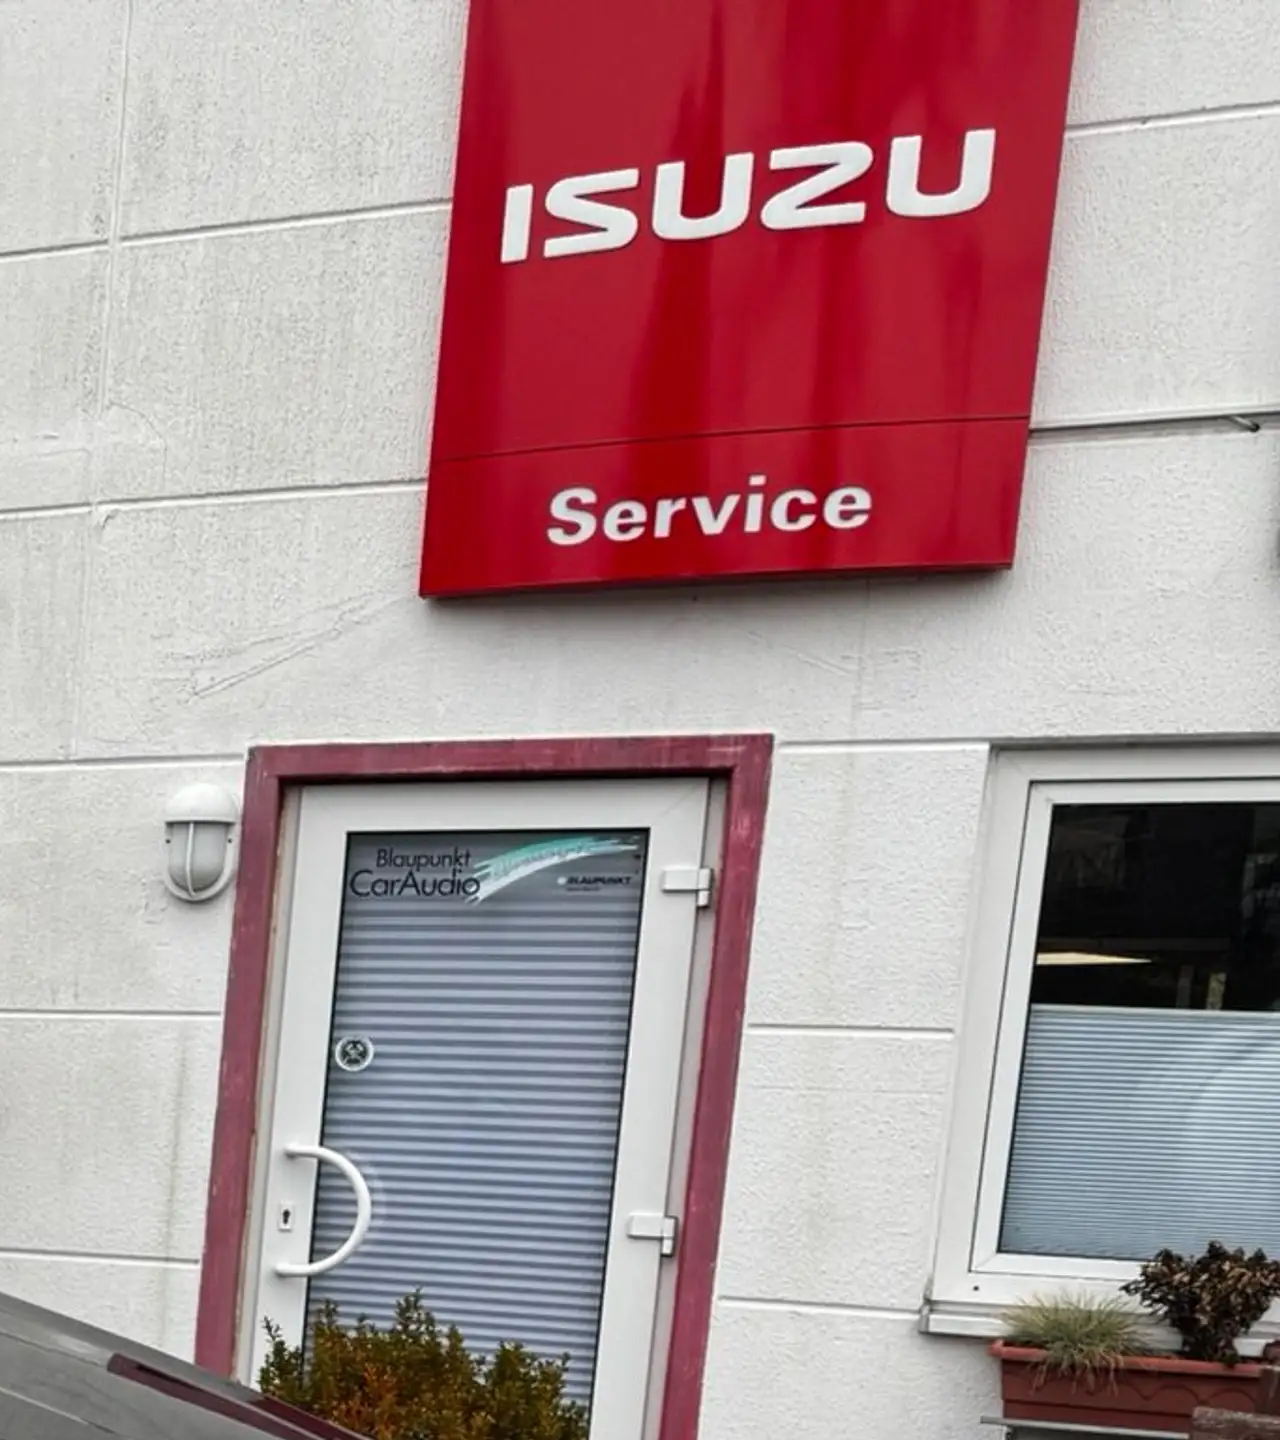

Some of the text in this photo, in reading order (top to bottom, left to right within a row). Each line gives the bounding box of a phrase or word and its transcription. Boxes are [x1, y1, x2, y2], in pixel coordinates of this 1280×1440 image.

[500, 128, 996, 263] ISUZU
[547, 475, 873, 546] Service
[349, 868, 481, 897] CarAudio
[376, 847, 471, 868] Blaupunkt
